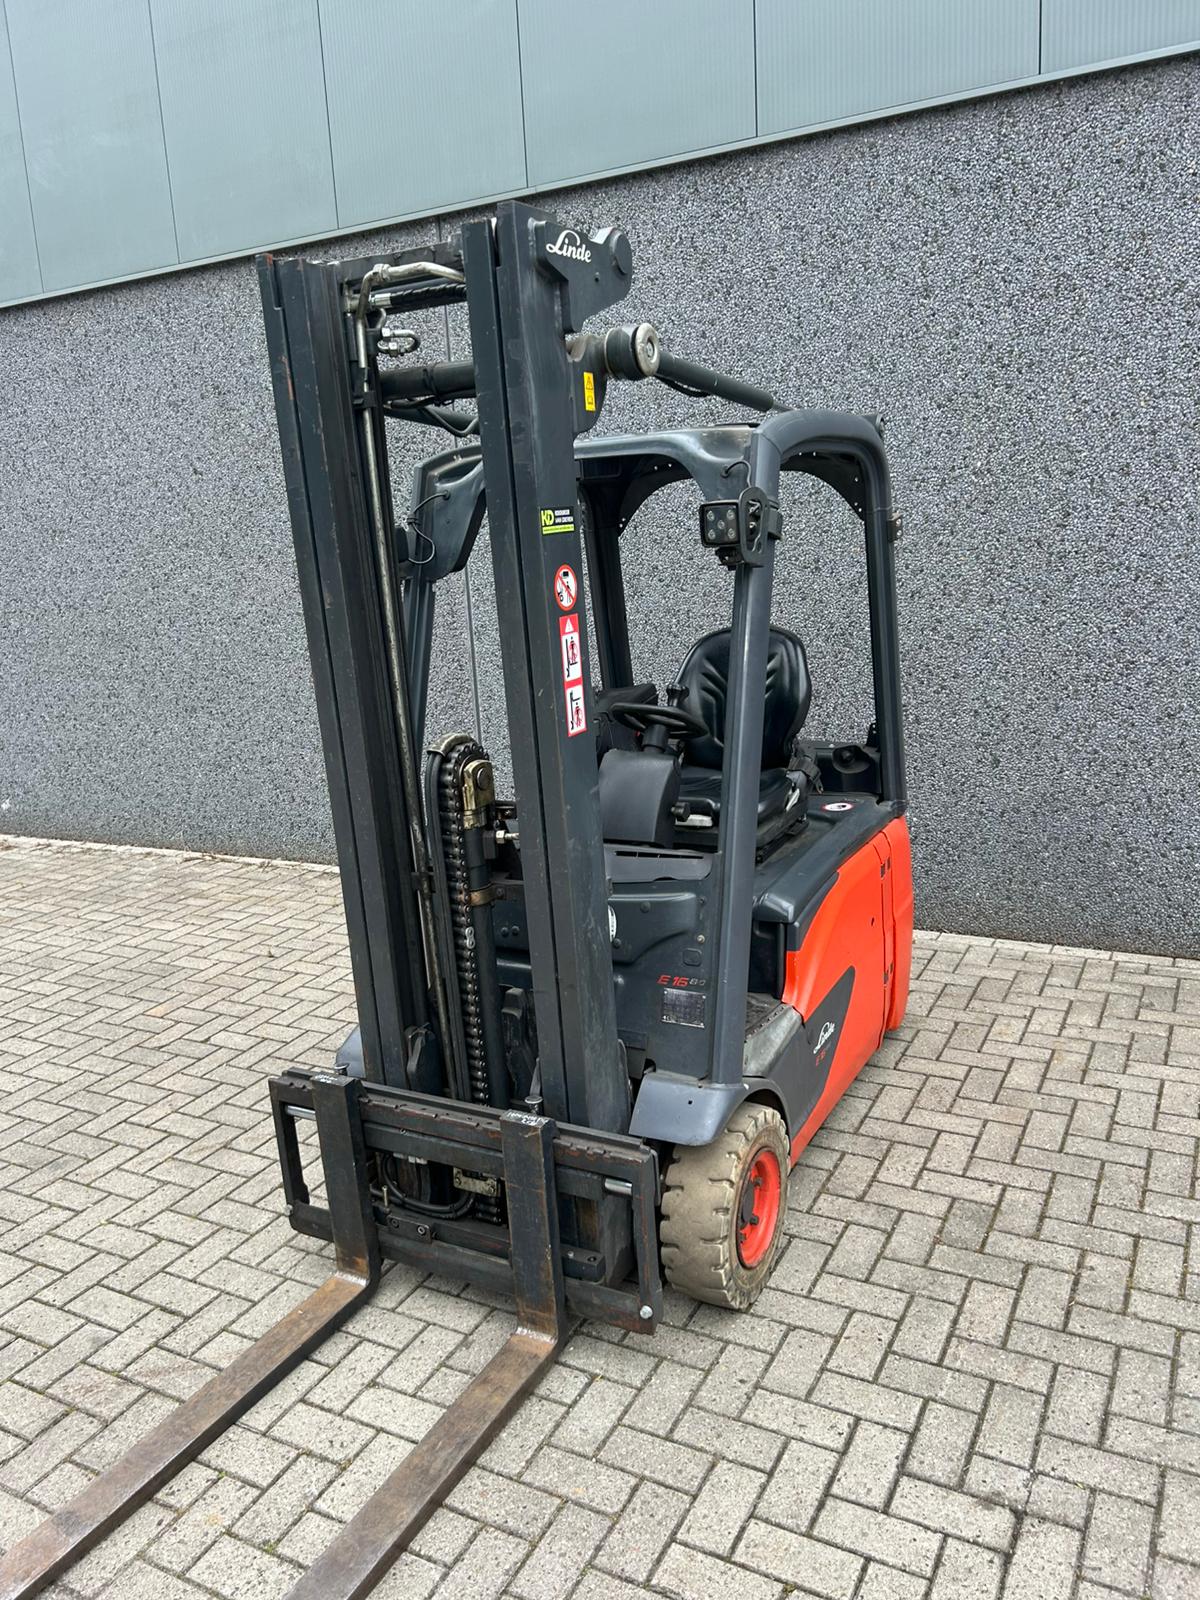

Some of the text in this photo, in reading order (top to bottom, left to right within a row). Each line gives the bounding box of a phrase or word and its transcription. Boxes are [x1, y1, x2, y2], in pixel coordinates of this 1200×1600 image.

[546, 230, 592, 263] Linde
[657, 975, 671, 985] E
[672, 976, 690, 987] 16
